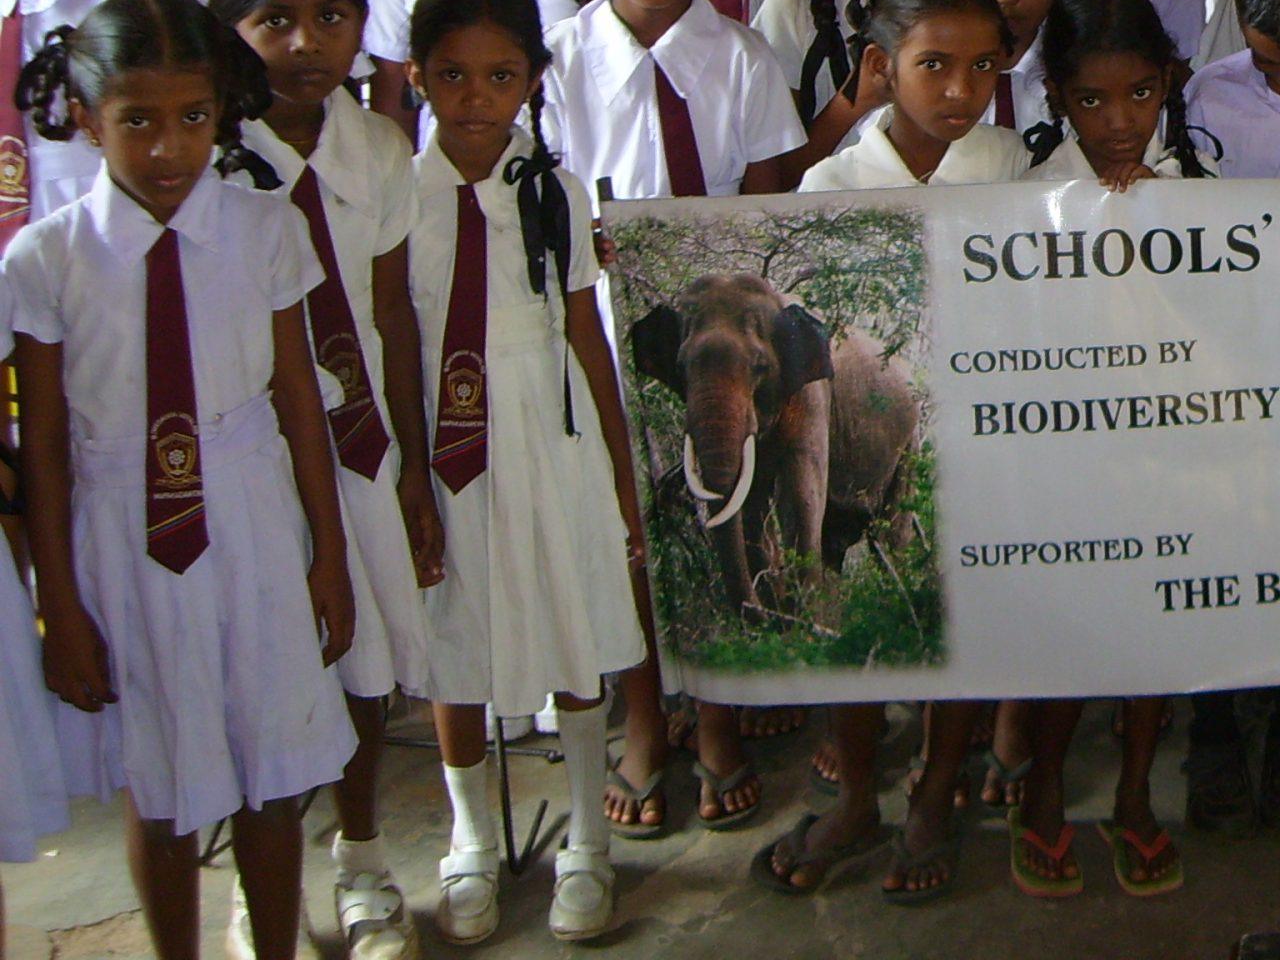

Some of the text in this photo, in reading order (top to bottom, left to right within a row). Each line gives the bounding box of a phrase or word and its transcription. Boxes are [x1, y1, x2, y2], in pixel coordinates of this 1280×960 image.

[963, 212, 1273, 283] SCHOOLS'
[949, 339, 1197, 374] CONDUCTED BY
[971, 386, 1280, 436] BIODIVERSITY
[960, 532, 1193, 568] SUPPORTED BY
[1154, 574, 1241, 612] THE
